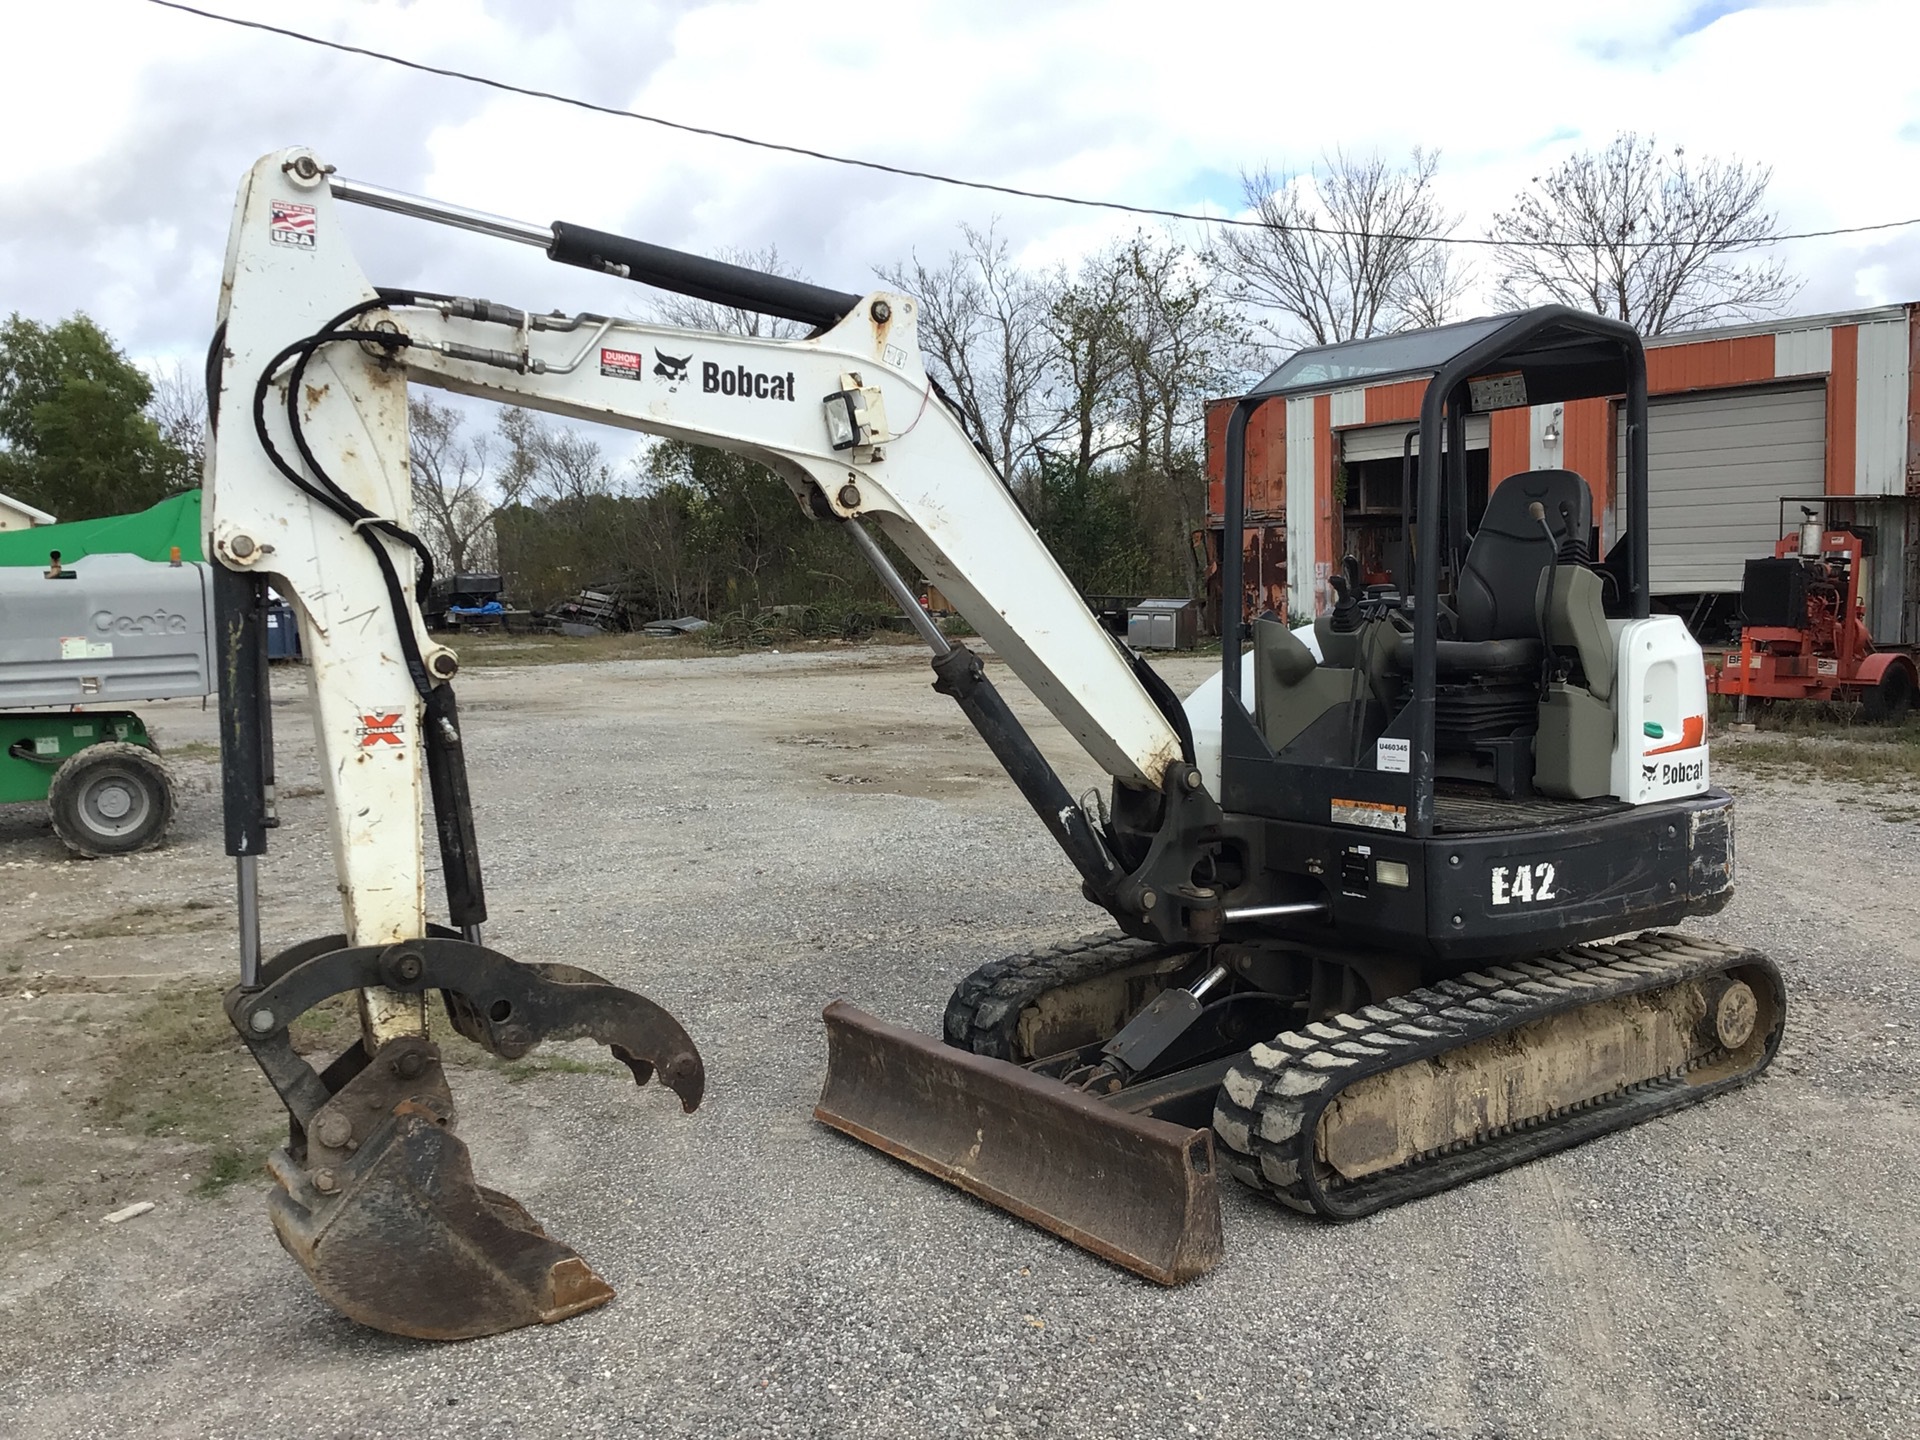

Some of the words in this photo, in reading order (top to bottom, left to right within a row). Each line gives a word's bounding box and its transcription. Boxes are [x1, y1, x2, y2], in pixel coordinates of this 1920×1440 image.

[273, 231, 312, 246] USA
[605, 351, 637, 363] DUHON
[703, 361, 795, 402] Bobcat
[91, 609, 187, 636] Genie
[1379, 743, 1408, 752] U460345
[1662, 760, 1703, 785] Bobcat
[1491, 863, 1555, 905] E42
